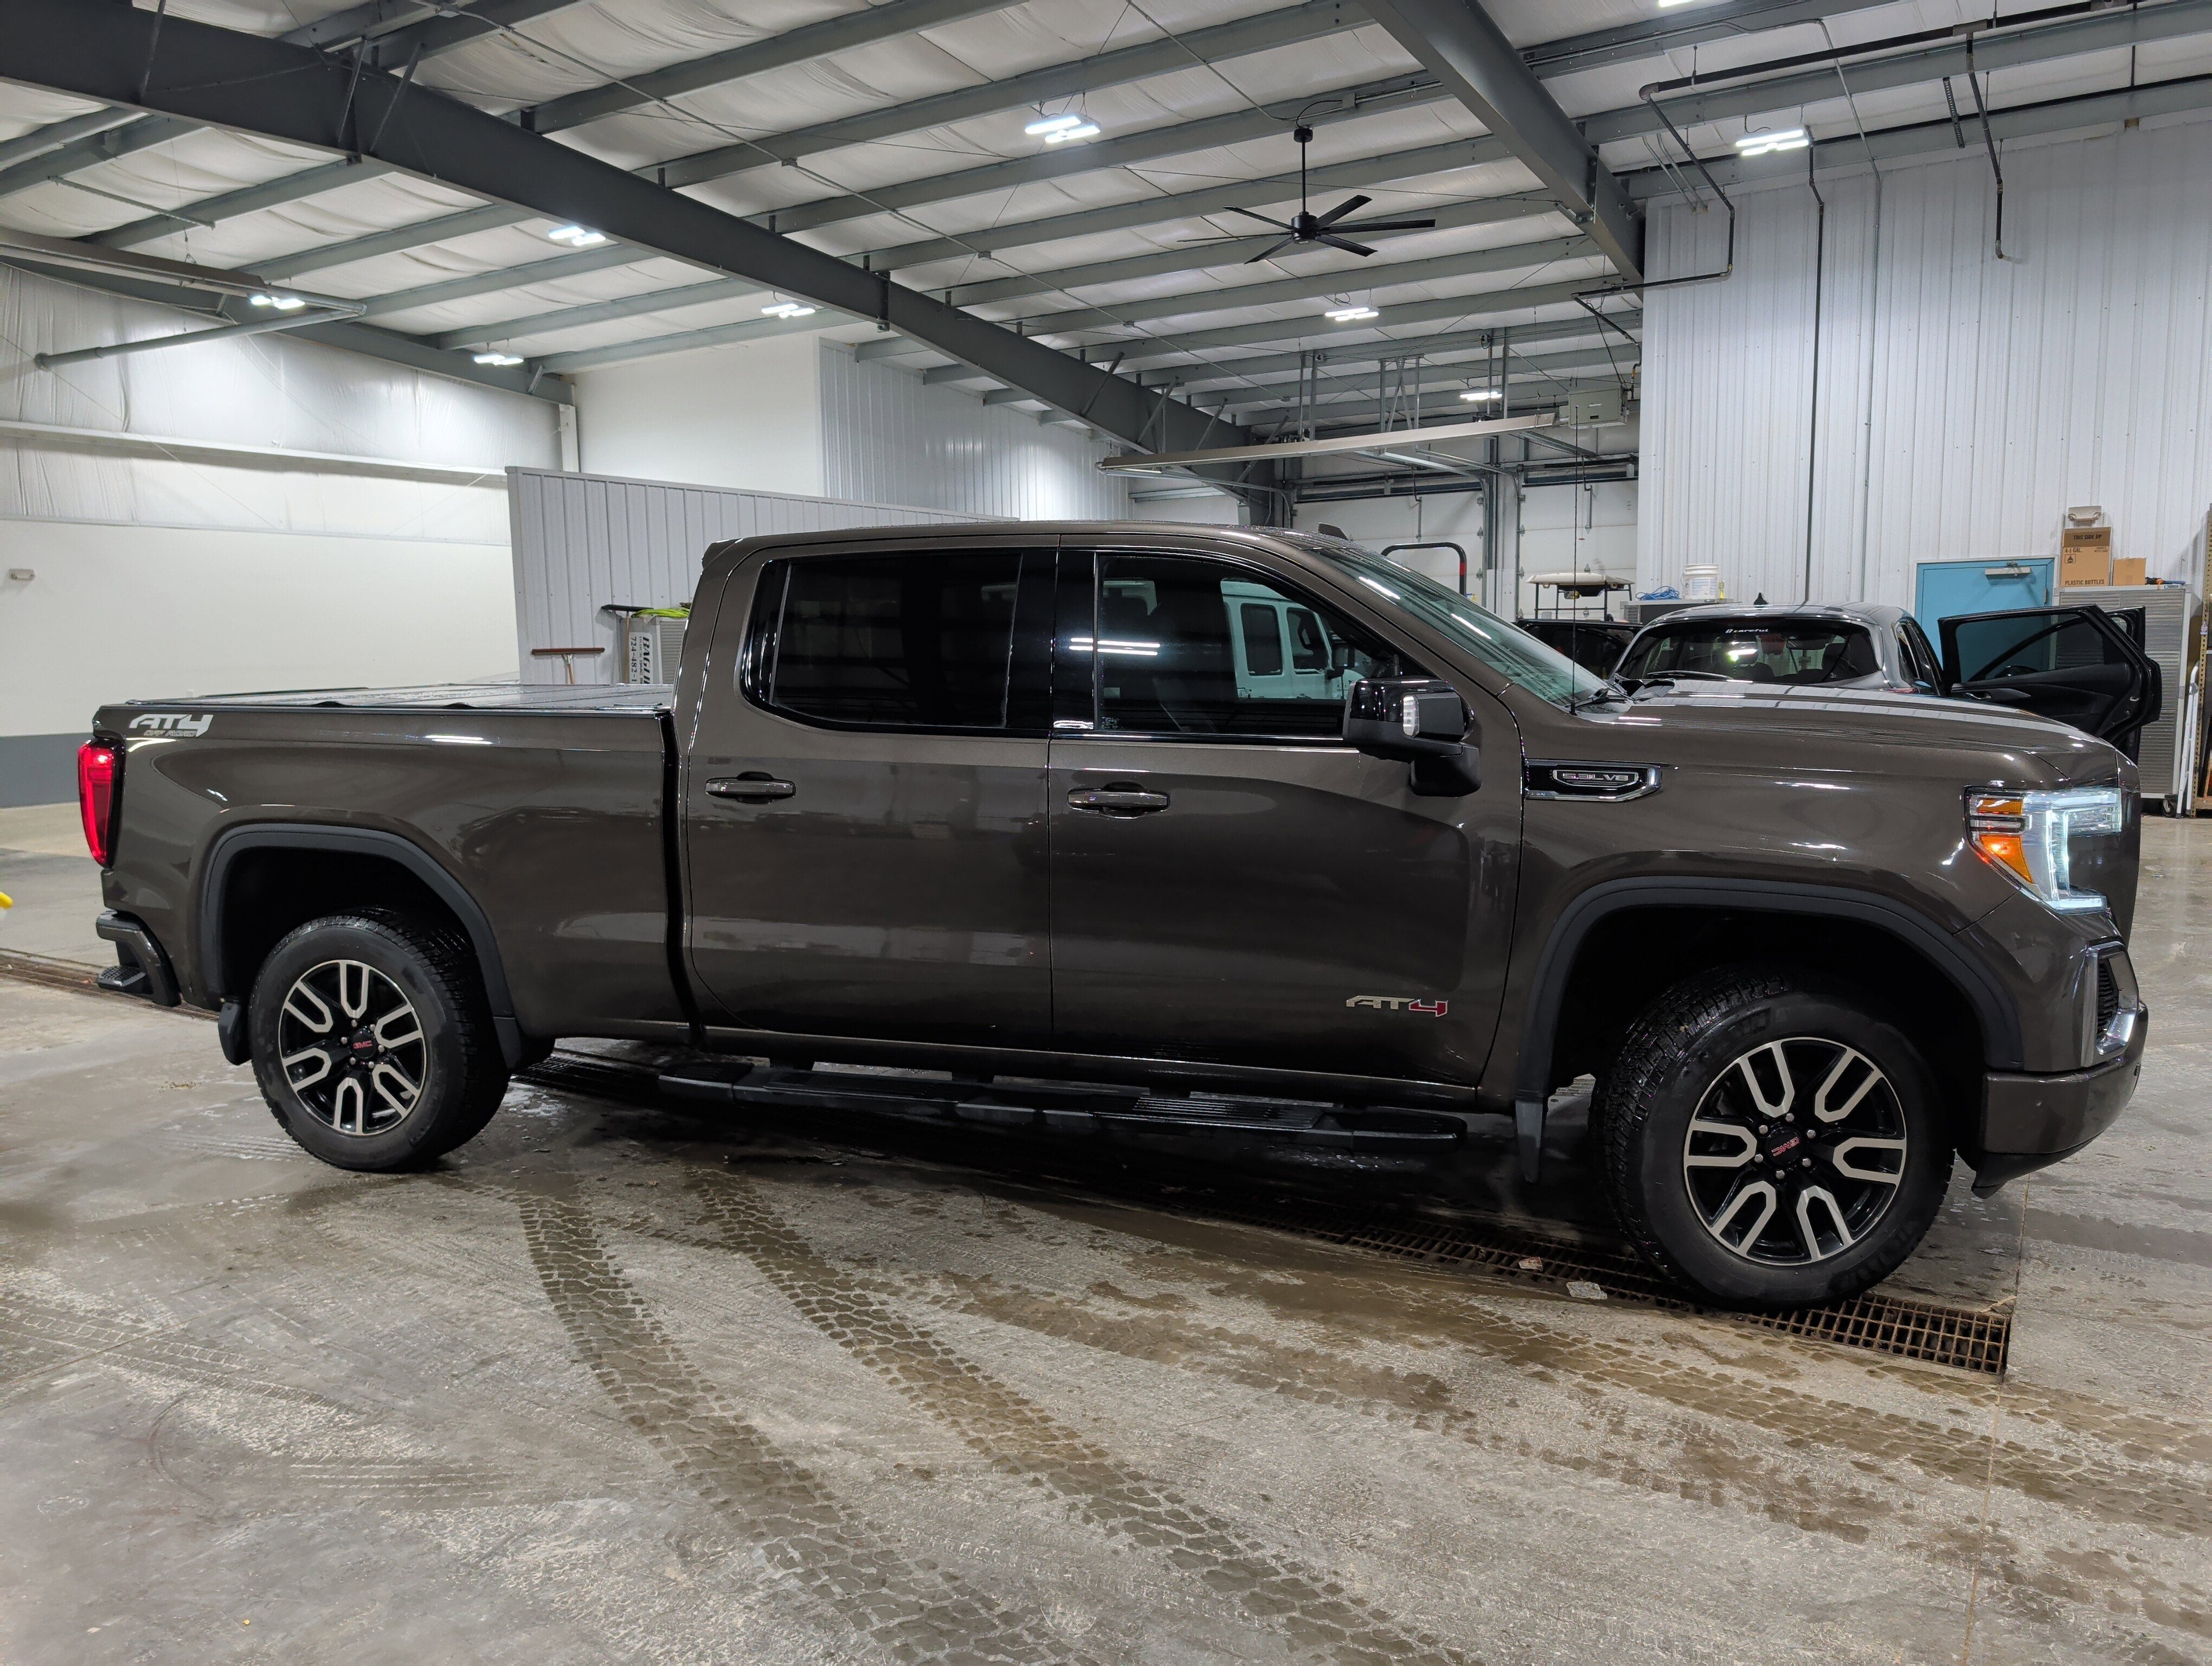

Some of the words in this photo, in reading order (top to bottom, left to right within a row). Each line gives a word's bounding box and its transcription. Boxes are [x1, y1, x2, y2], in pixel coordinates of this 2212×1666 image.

[129, 714, 214, 737] AT4
[1346, 995, 1449, 1017] AT4
[353, 1040, 372, 1049] GMC
[1771, 1137, 1799, 1156] GMC
